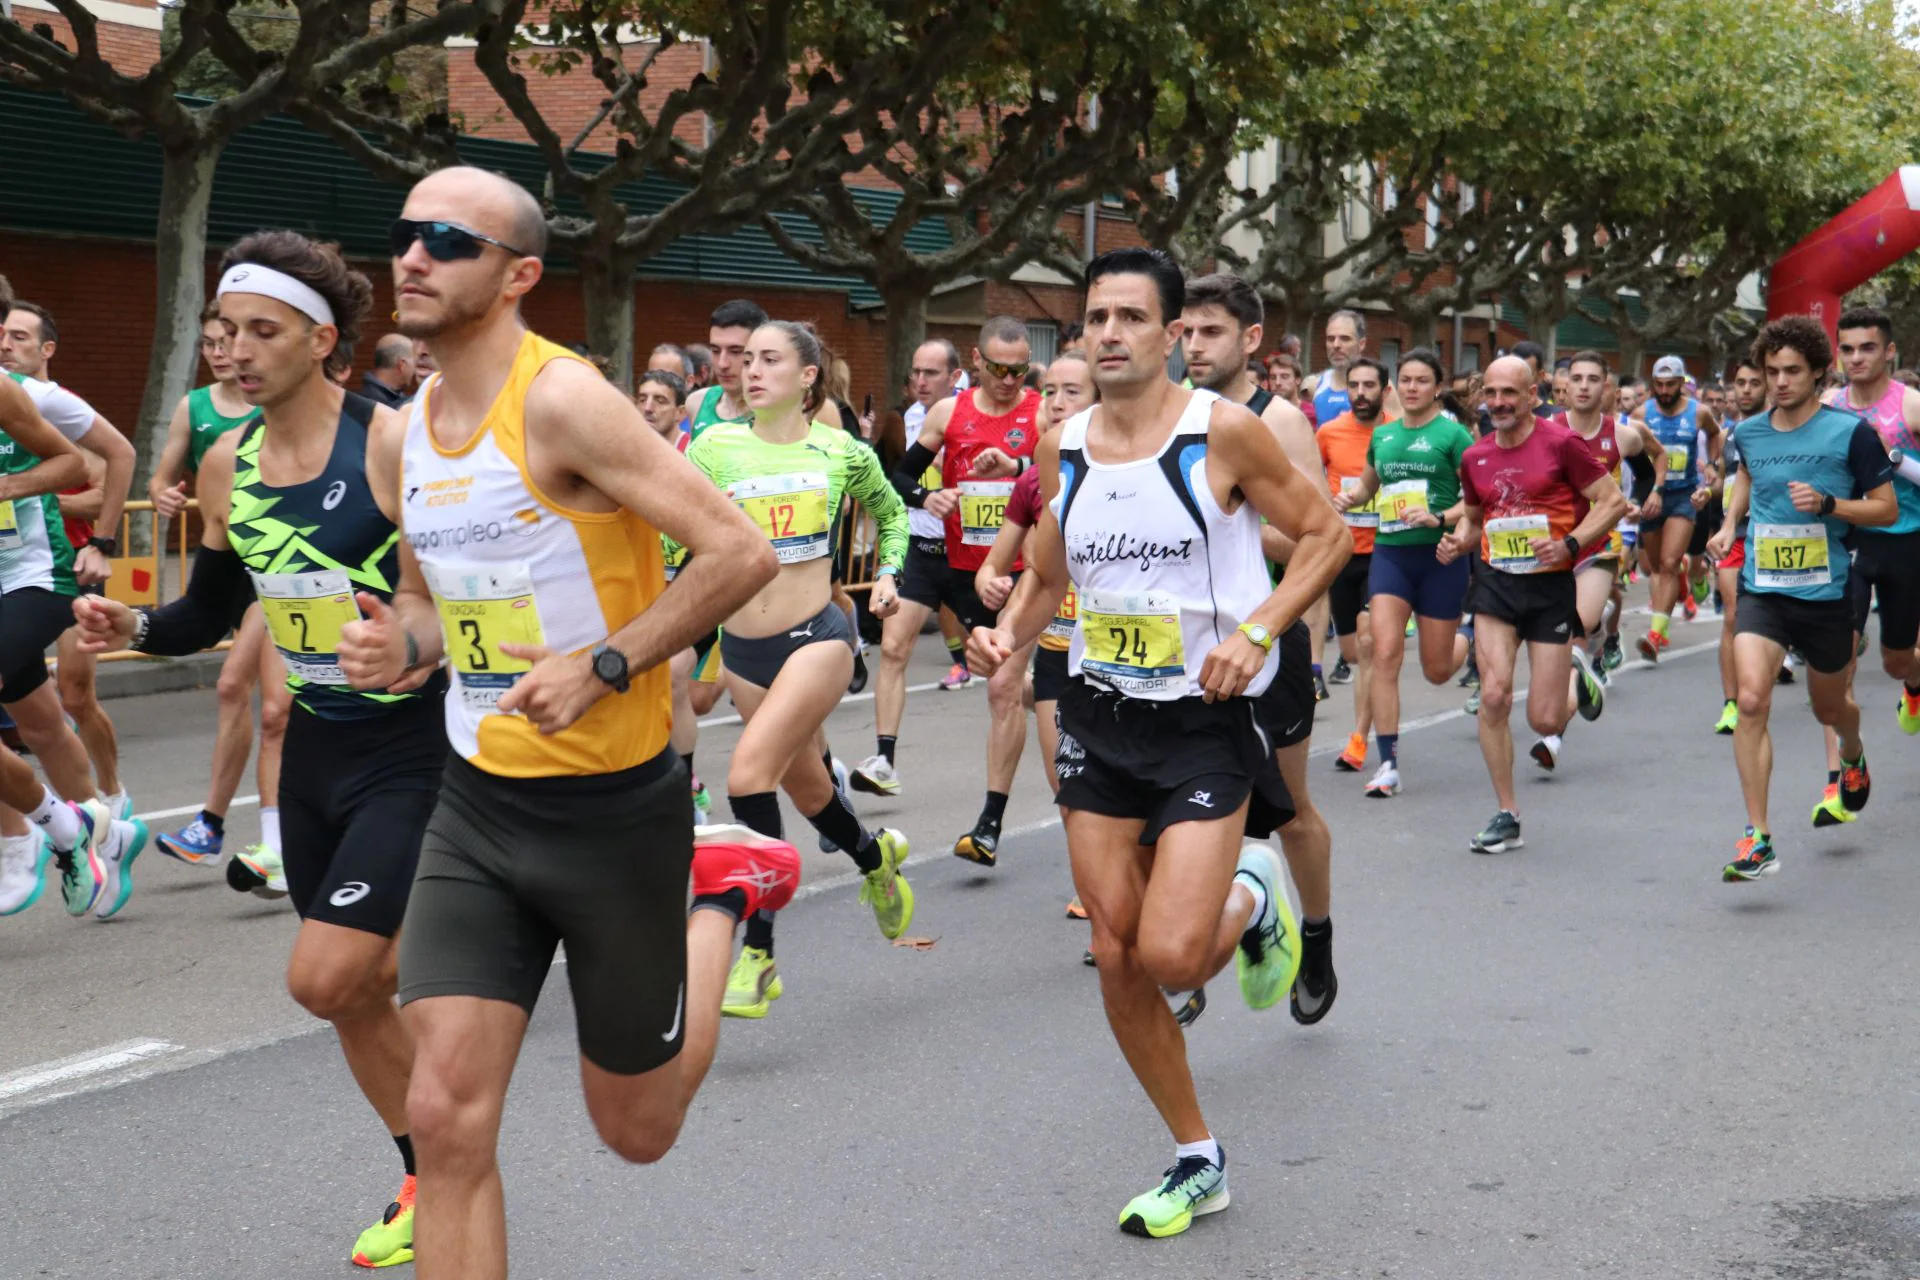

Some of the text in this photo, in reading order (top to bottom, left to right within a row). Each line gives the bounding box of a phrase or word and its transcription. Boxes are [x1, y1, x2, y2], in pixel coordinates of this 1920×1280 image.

[0, 441, 14, 455] ad
[1382, 461, 1437, 473] universidad
[1750, 454, 1830, 469] DYNAFIT
[773, 494, 801, 505] FORERO
[769, 504, 798, 538] 12
[976, 504, 1005, 527] 129
[406, 518, 502, 553] upompleo
[1507, 536, 1528, 556] 117
[1774, 545, 1806, 569] 137
[288, 613, 316, 652] 2
[459, 619, 490, 671] 3
[1109, 627, 1148, 666] 24
[1115, 679, 1168, 691] HYUNDAI
